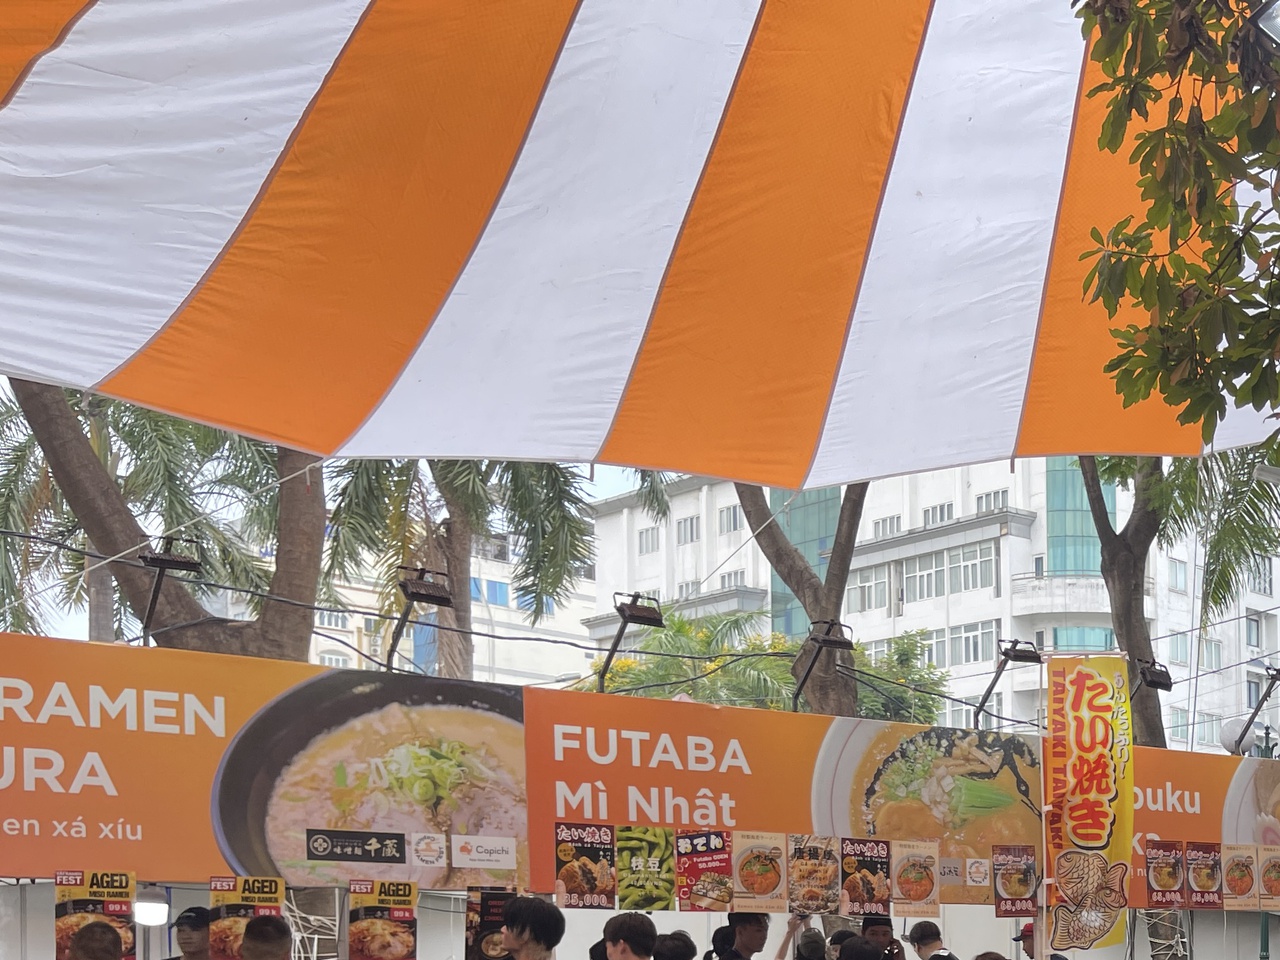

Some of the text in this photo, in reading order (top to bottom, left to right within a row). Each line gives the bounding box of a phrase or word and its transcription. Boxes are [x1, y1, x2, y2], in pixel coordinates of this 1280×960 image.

[0, 676, 226, 738] RAMEN
[1052, 668, 1067, 758] TAIYAKI
[554, 724, 752, 775] FUTABA
[1068, 669, 1114, 844] たい焼き
[555, 780, 608, 820] Mì
[52, 816, 87, 838] xá
[98, 818, 143, 841] xíu
[557, 825, 611, 843] たい焼き
[475, 845, 510, 857] Capichi
[677, 835, 724, 854] おでん
[843, 840, 888, 857] たい焼き
[631, 856, 661, 871] 枝豆
[57, 876, 82, 885] FEST
[89, 873, 129, 889] AGED
[211, 881, 235, 890] FEST
[242, 879, 278, 894] AGED
[350, 884, 373, 893] FEST
[378, 882, 412, 897] AGED
